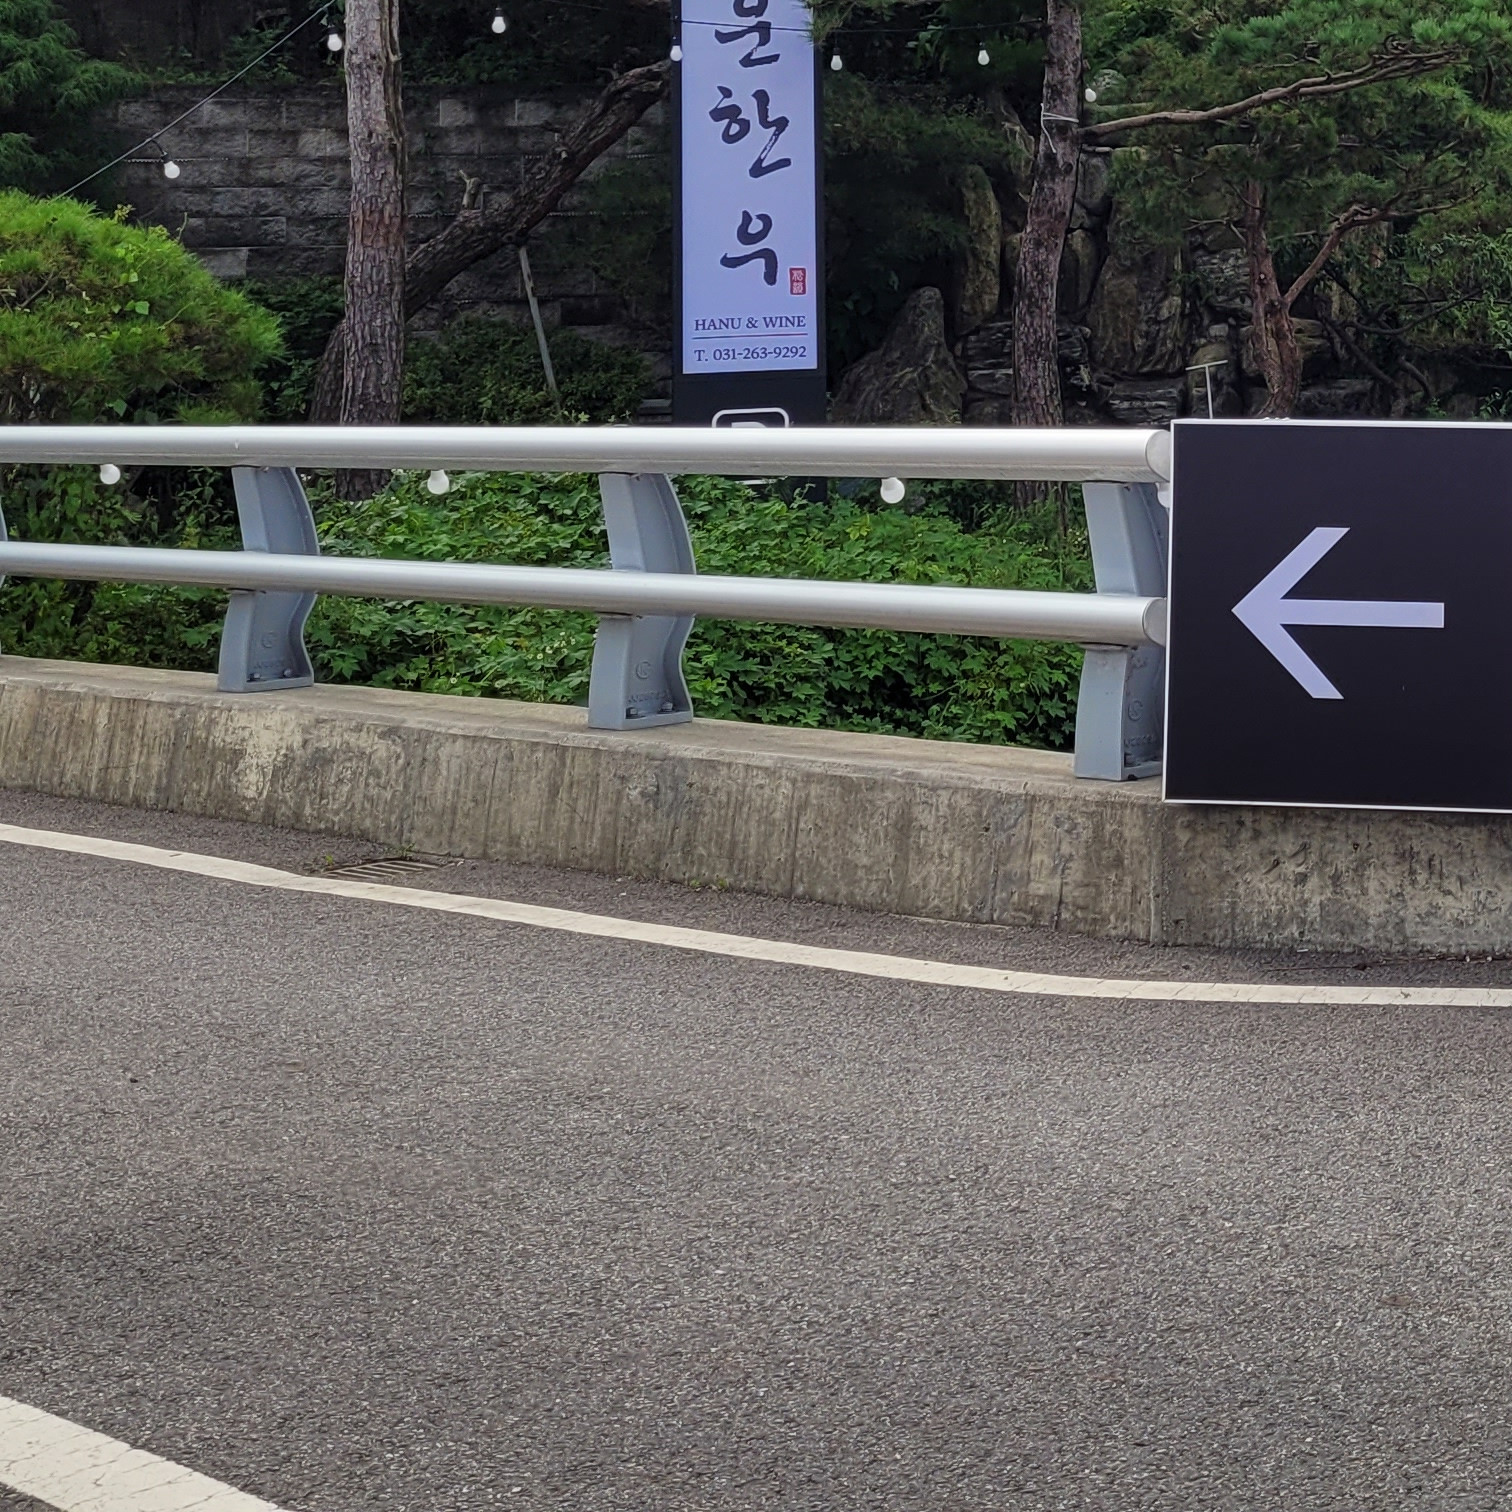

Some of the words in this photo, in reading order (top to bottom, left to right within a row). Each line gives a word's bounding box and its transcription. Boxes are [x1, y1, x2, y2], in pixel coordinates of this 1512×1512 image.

[694, 317, 742, 331] HANU
[745, 316, 759, 329] &
[762, 315, 807, 329] WINE
[693, 349, 709, 362] T.
[712, 345, 807, 361] 031-263-9292
